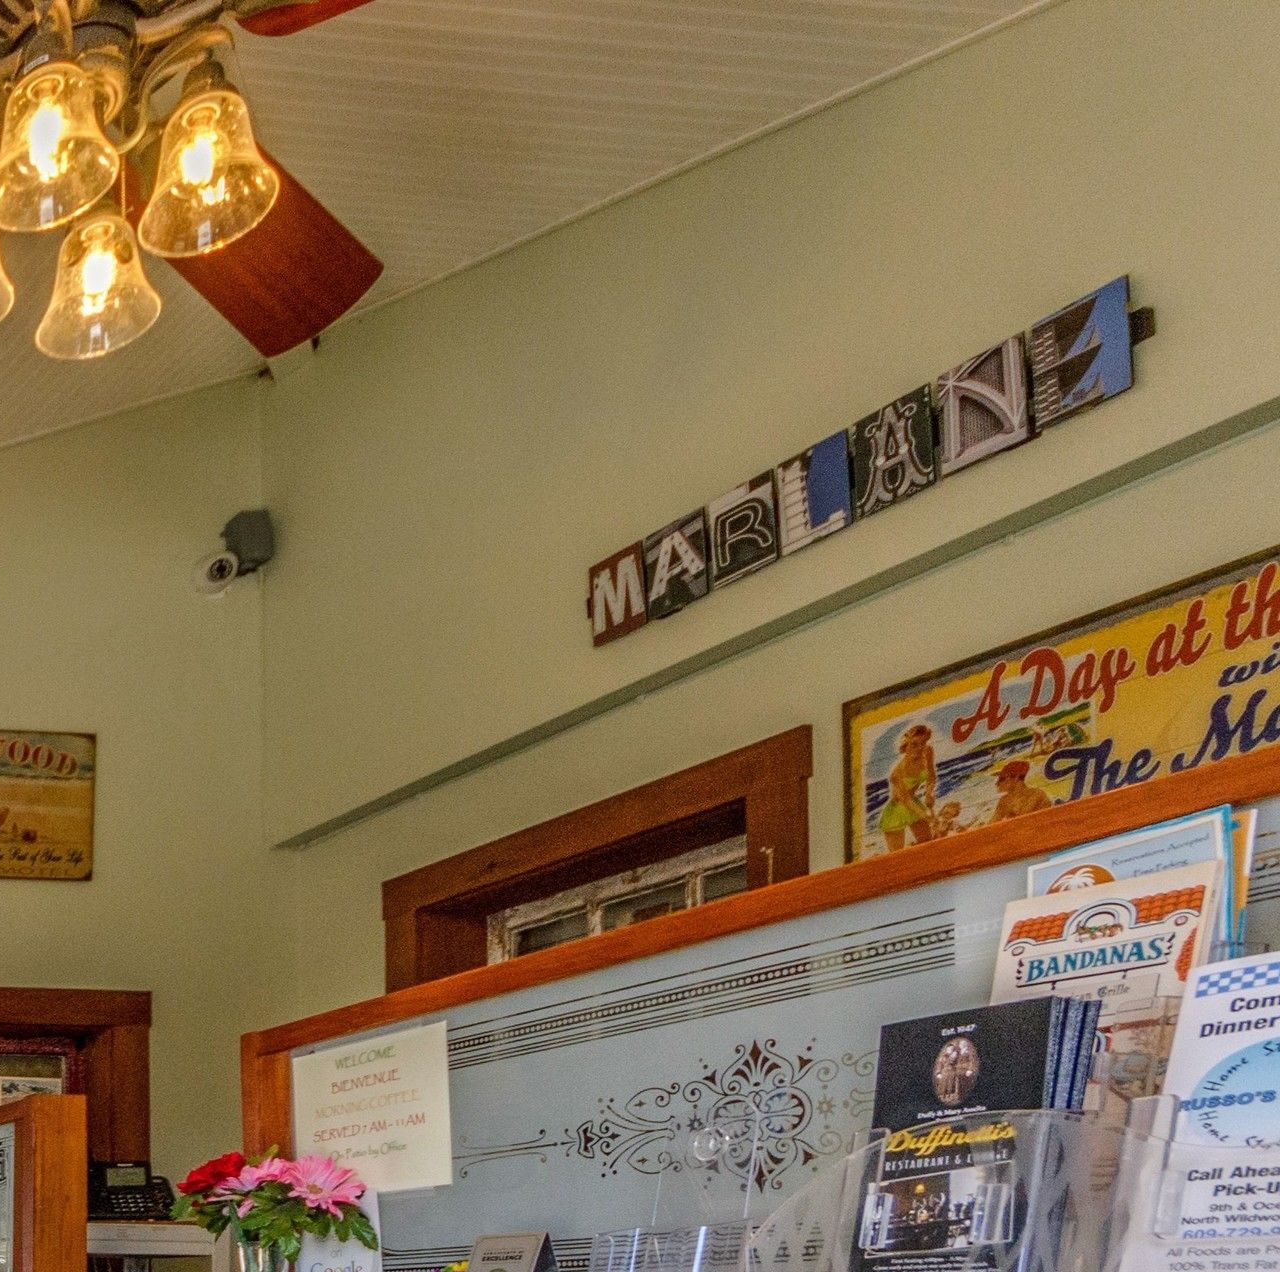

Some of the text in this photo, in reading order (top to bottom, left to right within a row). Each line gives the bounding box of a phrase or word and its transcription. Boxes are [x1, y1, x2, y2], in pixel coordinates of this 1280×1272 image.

[951, 662, 1010, 743] A
[1019, 648, 1136, 712] Day
[1145, 599, 1212, 677] at
[1043, 739, 1161, 803] The
[1026, 938, 1165, 982] BANDANAS
[1200, 1016, 1280, 1038] Dinner
[335, 1045, 397, 1069] WELCOME
[331, 1068, 401, 1094] BIENVENUE
[1203, 1057, 1249, 1091] Home
[368, 1088, 421, 1111] COFFEE
[1178, 1090, 1277, 1112] RUSSO'S
[313, 1124, 361, 1143] SERVED
[369, 1120, 388, 1133] AM
[406, 1112, 426, 1126] AM
[380, 1139, 408, 1156] Office
[885, 1154, 950, 1171] RESTAURANT
[1188, 1168, 1223, 1181] Call
[1213, 1181, 1280, 1197] Pick-U
[1209, 1203, 1233, 1213] 9th
[1237, 1202, 1247, 1211] &
[1181, 1216, 1220, 1226] North
[481, 1254, 524, 1263] EXCELLENCE
[1166, 1248, 1182, 1257] All
[1187, 1246, 1231, 1257] Foods
[1235, 1247, 1260, 1256] are
[1169, 1260, 1279, 1272] 100% Trans Fat
